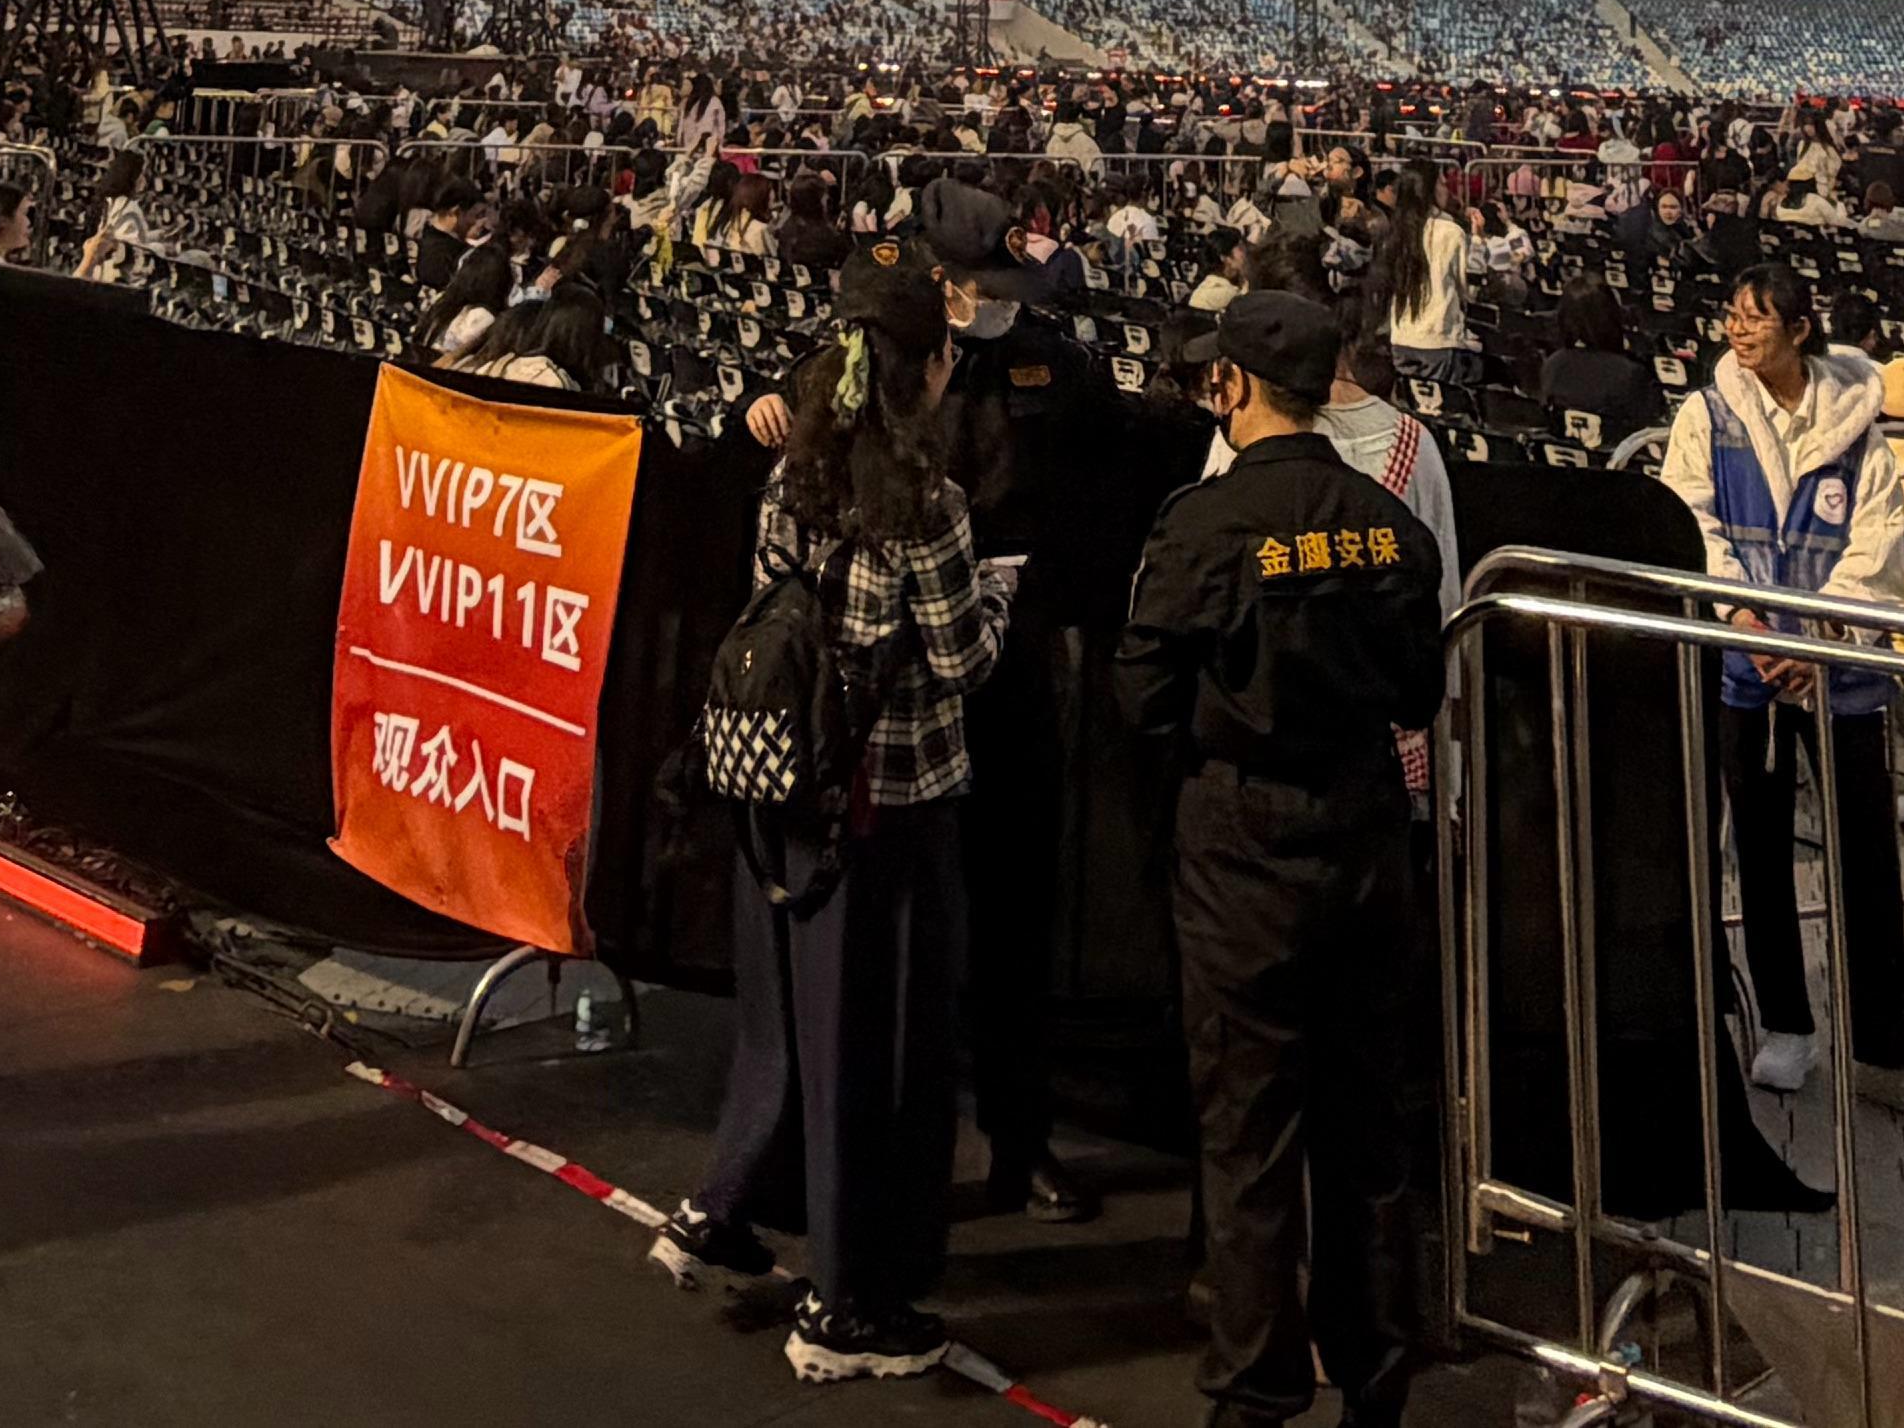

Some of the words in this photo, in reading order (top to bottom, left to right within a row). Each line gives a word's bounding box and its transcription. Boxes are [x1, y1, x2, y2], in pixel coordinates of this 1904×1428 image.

[396, 444, 565, 559] VVIP7区
[379, 539, 590, 672] VVIP11区
[372, 711, 536, 842] 观众入口
